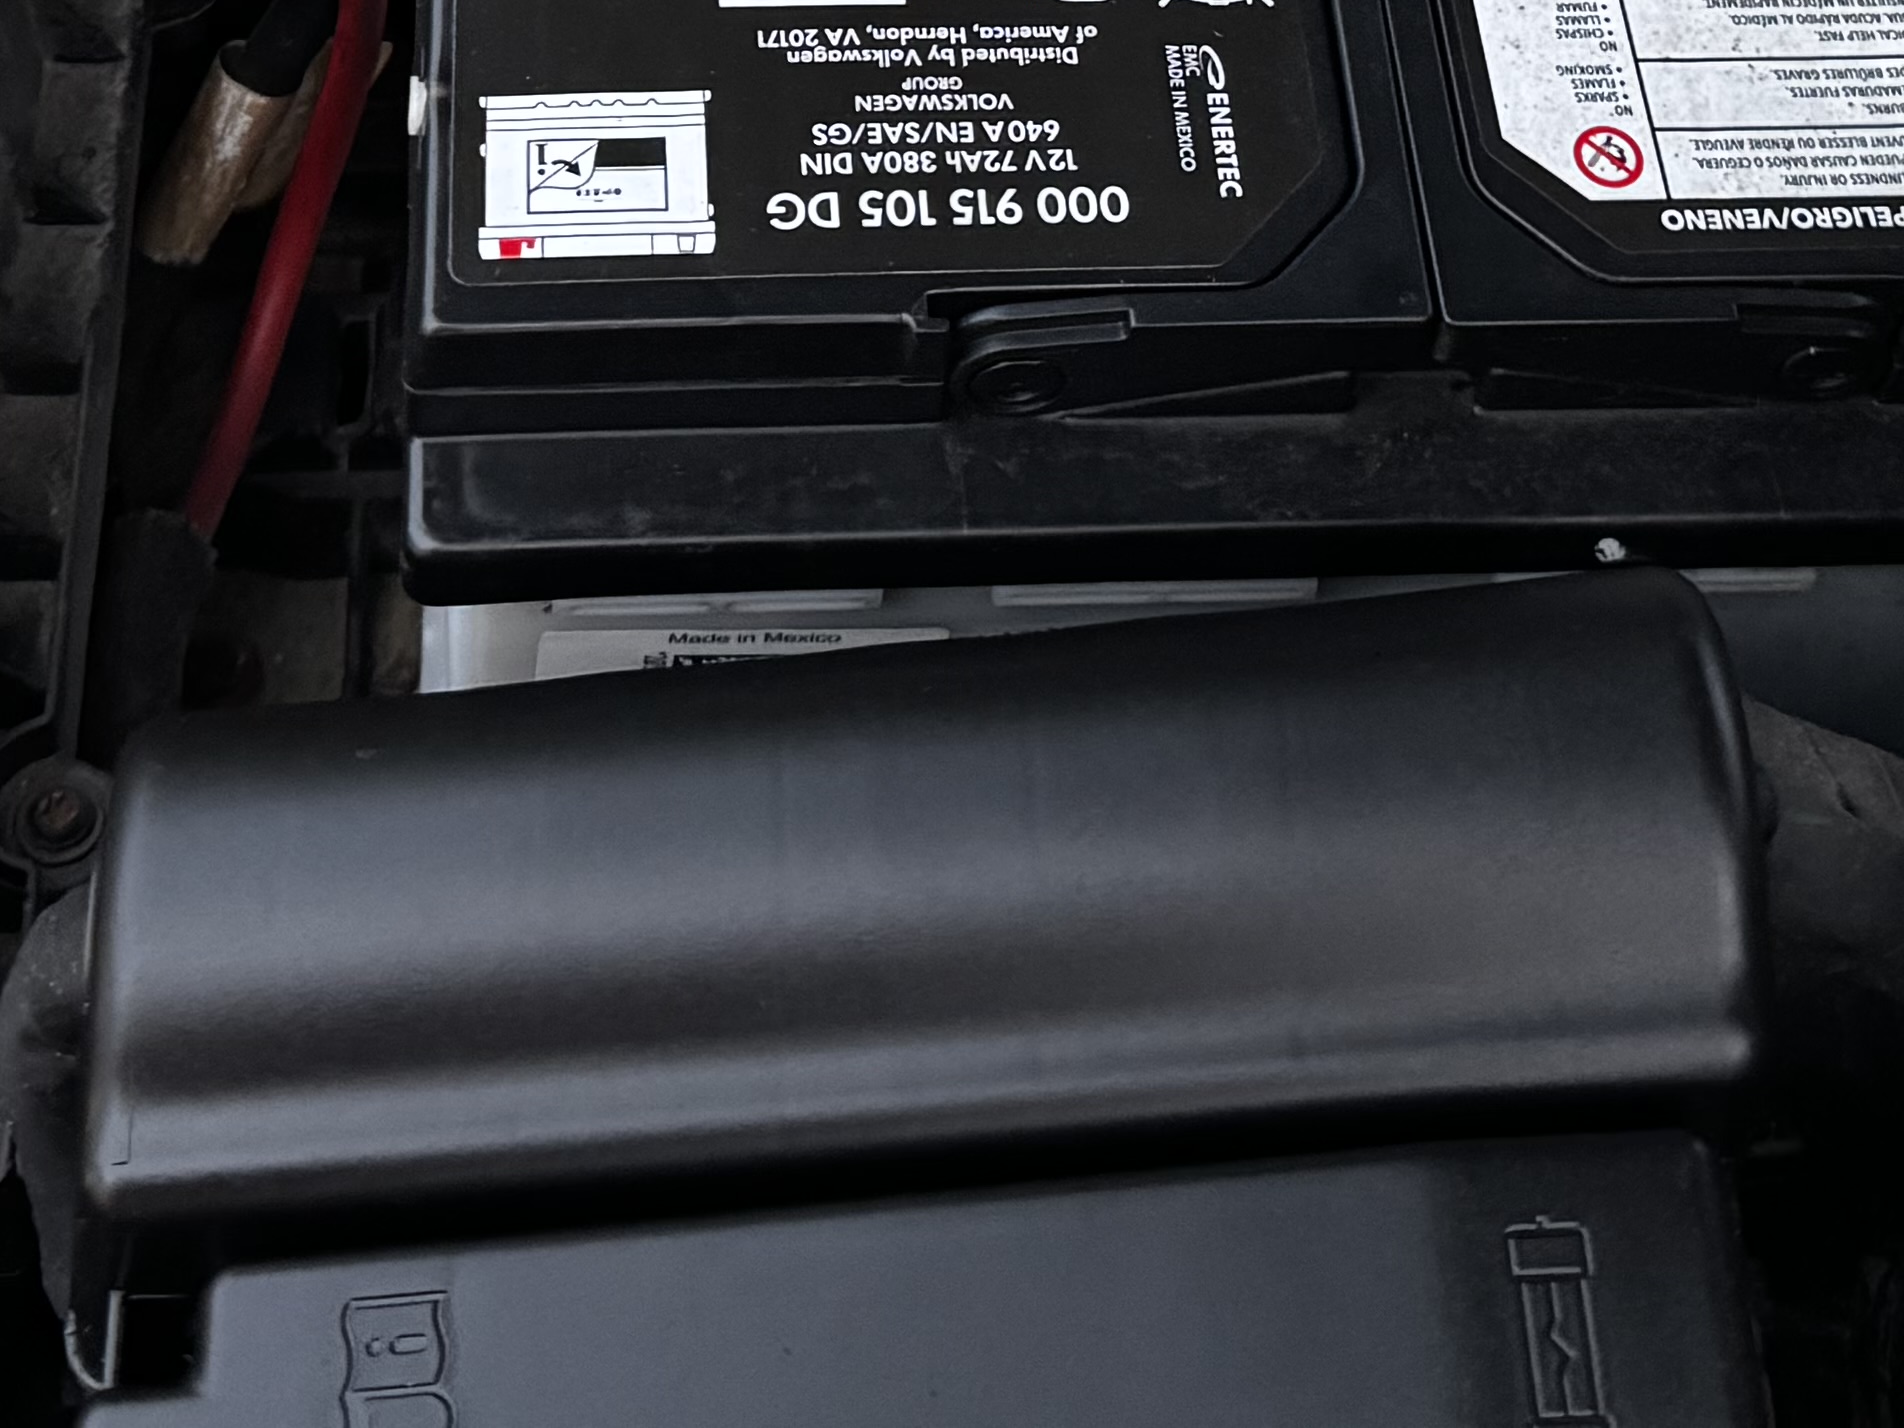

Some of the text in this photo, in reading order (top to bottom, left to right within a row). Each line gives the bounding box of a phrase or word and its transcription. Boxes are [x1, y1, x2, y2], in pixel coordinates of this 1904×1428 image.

[1555, 2, 1598, 11] FUMAR
[1555, 15, 1601, 24] LLAMAS
[758, 24, 1097, 48] of America, Herndon, VA 20171
[1554, 28, 1604, 38] CHISPAS
[1813, 30, 1844, 41] FAST.
[1844, 29, 1875, 41] HELP
[1598, 41, 1617, 51] NO
[787, 45, 1078, 67] Distributed by Volkswagen
[1182, 45, 1200, 77] EMC
[1555, 64, 1613, 75] SMOKING
[902, 77, 962, 90] GROUP
[1569, 77, 1616, 88] FLAMES
[1573, 91, 1619, 102] SPARKS
[1784, 85, 1840, 97] FUERTES.
[855, 94, 1014, 111] VOLKSWAGEN
[1165, 45, 1197, 172] MADE IN MEXICO
[1613, 105, 1633, 115] NO
[812, 120, 1059, 145] 640A EN/SAE/GS
[1206, 92, 1243, 198] ENERTEC
[1688, 138, 1746, 150] AVEUGLE.
[1747, 137, 1795, 149] RENDRE
[1796, 137, 1816, 149] OU
[1817, 136, 1868, 148] BLESSER
[800, 149, 1078, 175] 12V 72Ah 380A DIN
[1691, 155, 1752, 168] CEGUERA.
[1752, 155, 1764, 167] O
[1764, 155, 1809, 170] DAÑOS
[1809, 154, 1858, 166] CAUSAR
[1779, 173, 1827, 185] INJURY.
[1828, 173, 1847, 184] OR
[767, 186, 1129, 230] 000 915 105 DG
[668, 632, 842, 644] Made in Mexico
